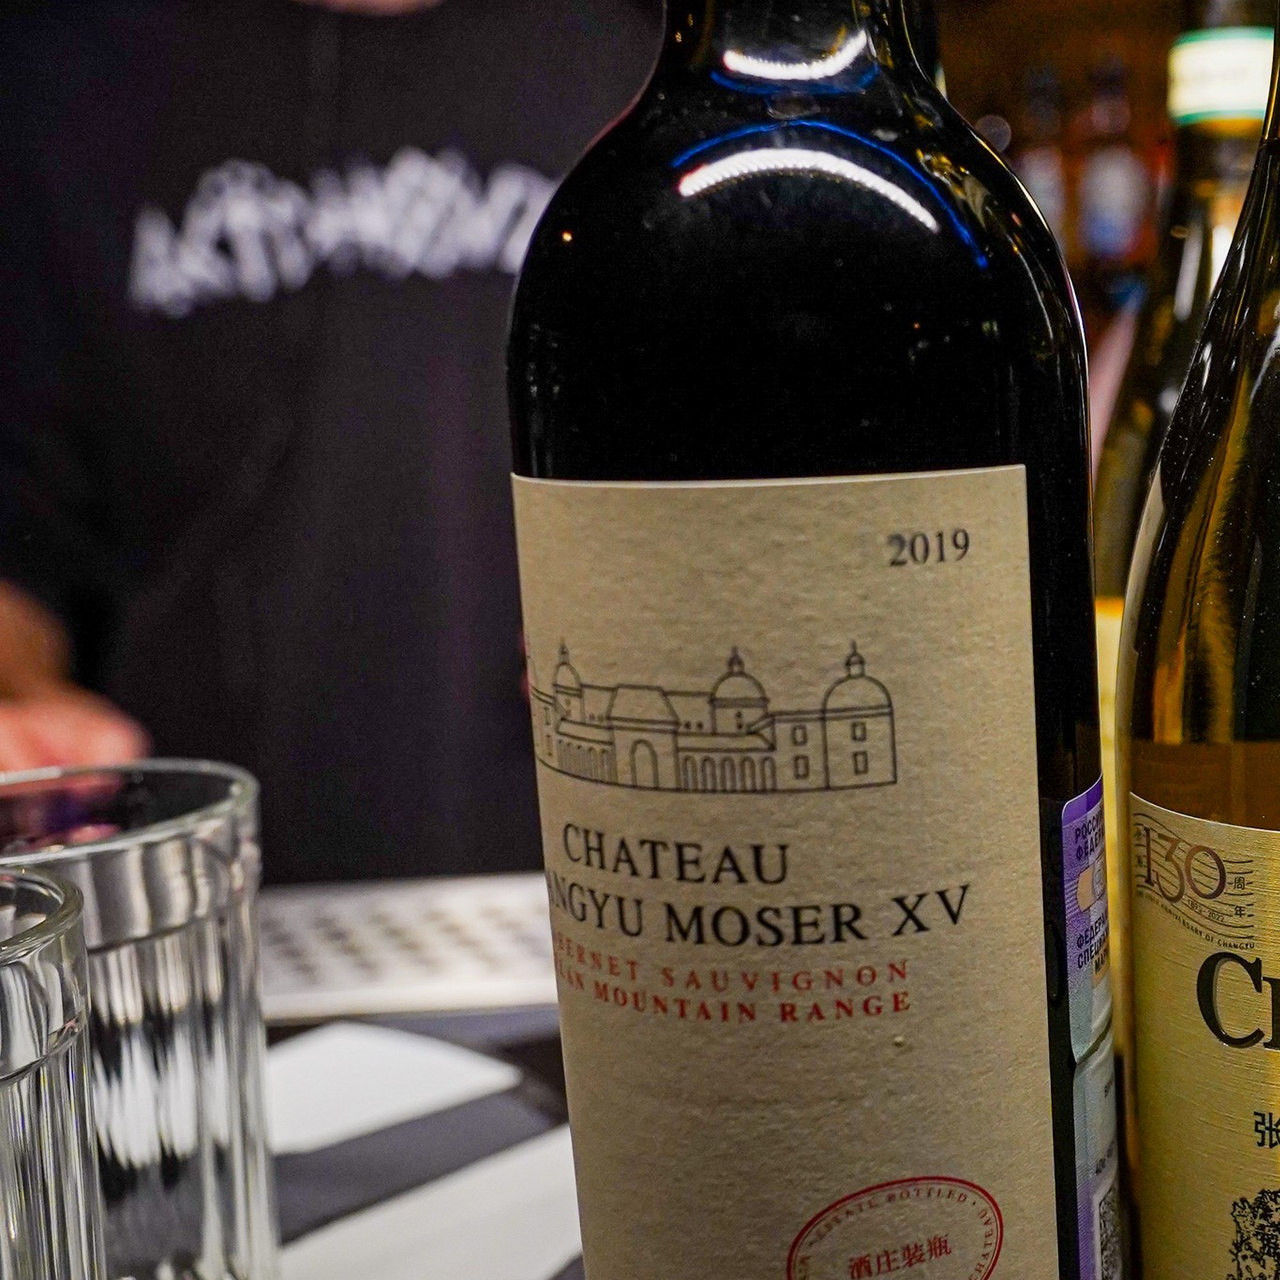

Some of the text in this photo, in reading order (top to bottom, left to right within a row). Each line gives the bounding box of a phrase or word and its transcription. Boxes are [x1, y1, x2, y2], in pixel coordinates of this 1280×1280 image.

[888, 528, 970, 567] 2019
[562, 822, 790, 885] CHATEAU
[1142, 826, 1227, 904] 130
[664, 902, 869, 948] MOSER
[891, 883, 971, 937] XV
[594, 980, 756, 1023] MOUNTAIN
[780, 990, 911, 1023] RANGE
[660, 959, 908, 993] SAUVIGNON
